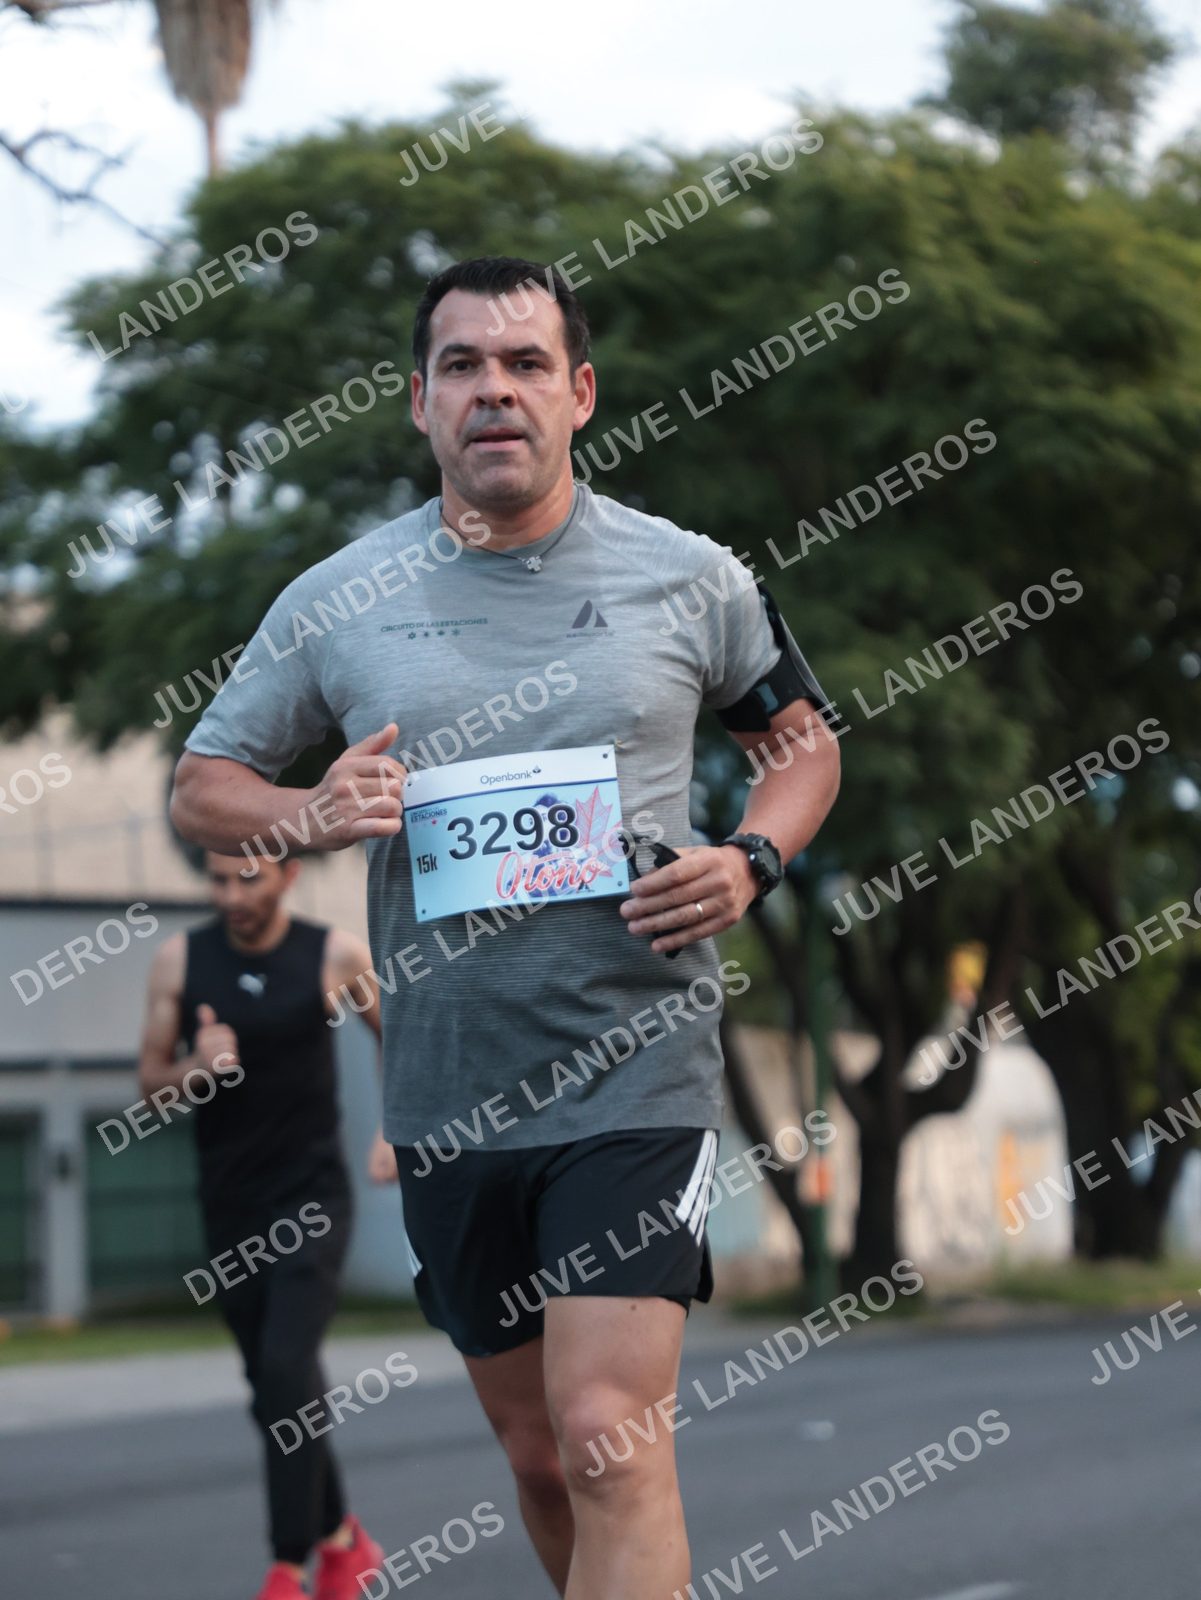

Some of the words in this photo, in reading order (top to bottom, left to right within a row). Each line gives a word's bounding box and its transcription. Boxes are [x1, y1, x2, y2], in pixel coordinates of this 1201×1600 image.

[480, 770, 532, 785] Openbank
[410, 808, 448, 824] ESTACIONES
[447, 804, 579, 860] 3298
[416, 853, 438, 875] 15k
